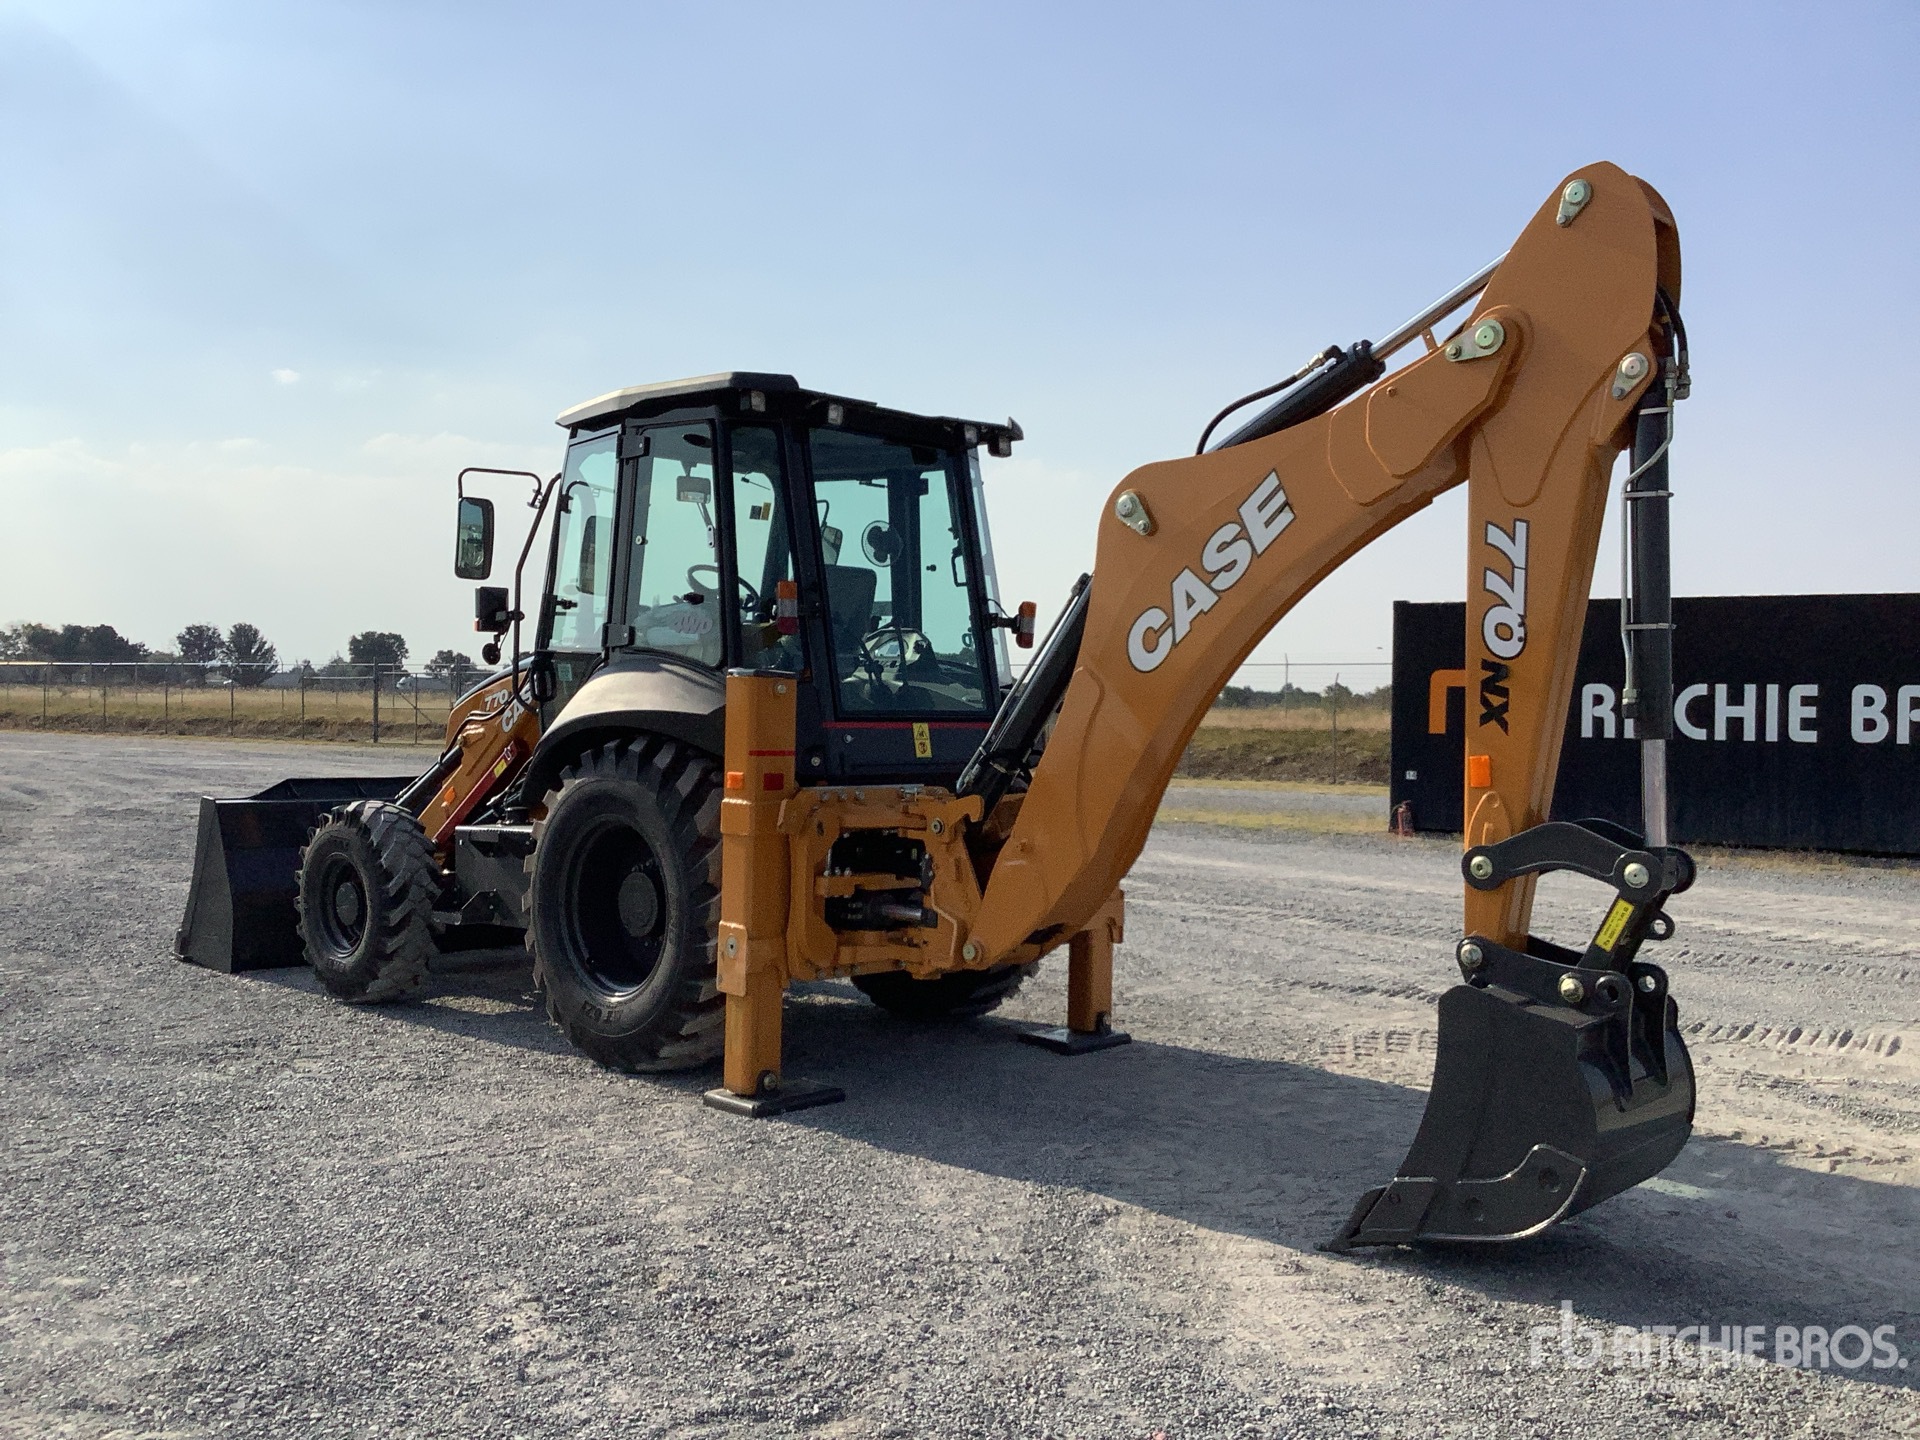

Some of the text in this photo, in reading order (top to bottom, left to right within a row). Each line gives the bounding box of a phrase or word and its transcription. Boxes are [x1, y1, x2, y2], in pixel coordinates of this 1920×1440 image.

[1127, 468, 1296, 673] CASE
[485, 689, 508, 711] 770
[501, 683, 533, 733] CAS
[1580, 683, 1819, 743] RCHIE
